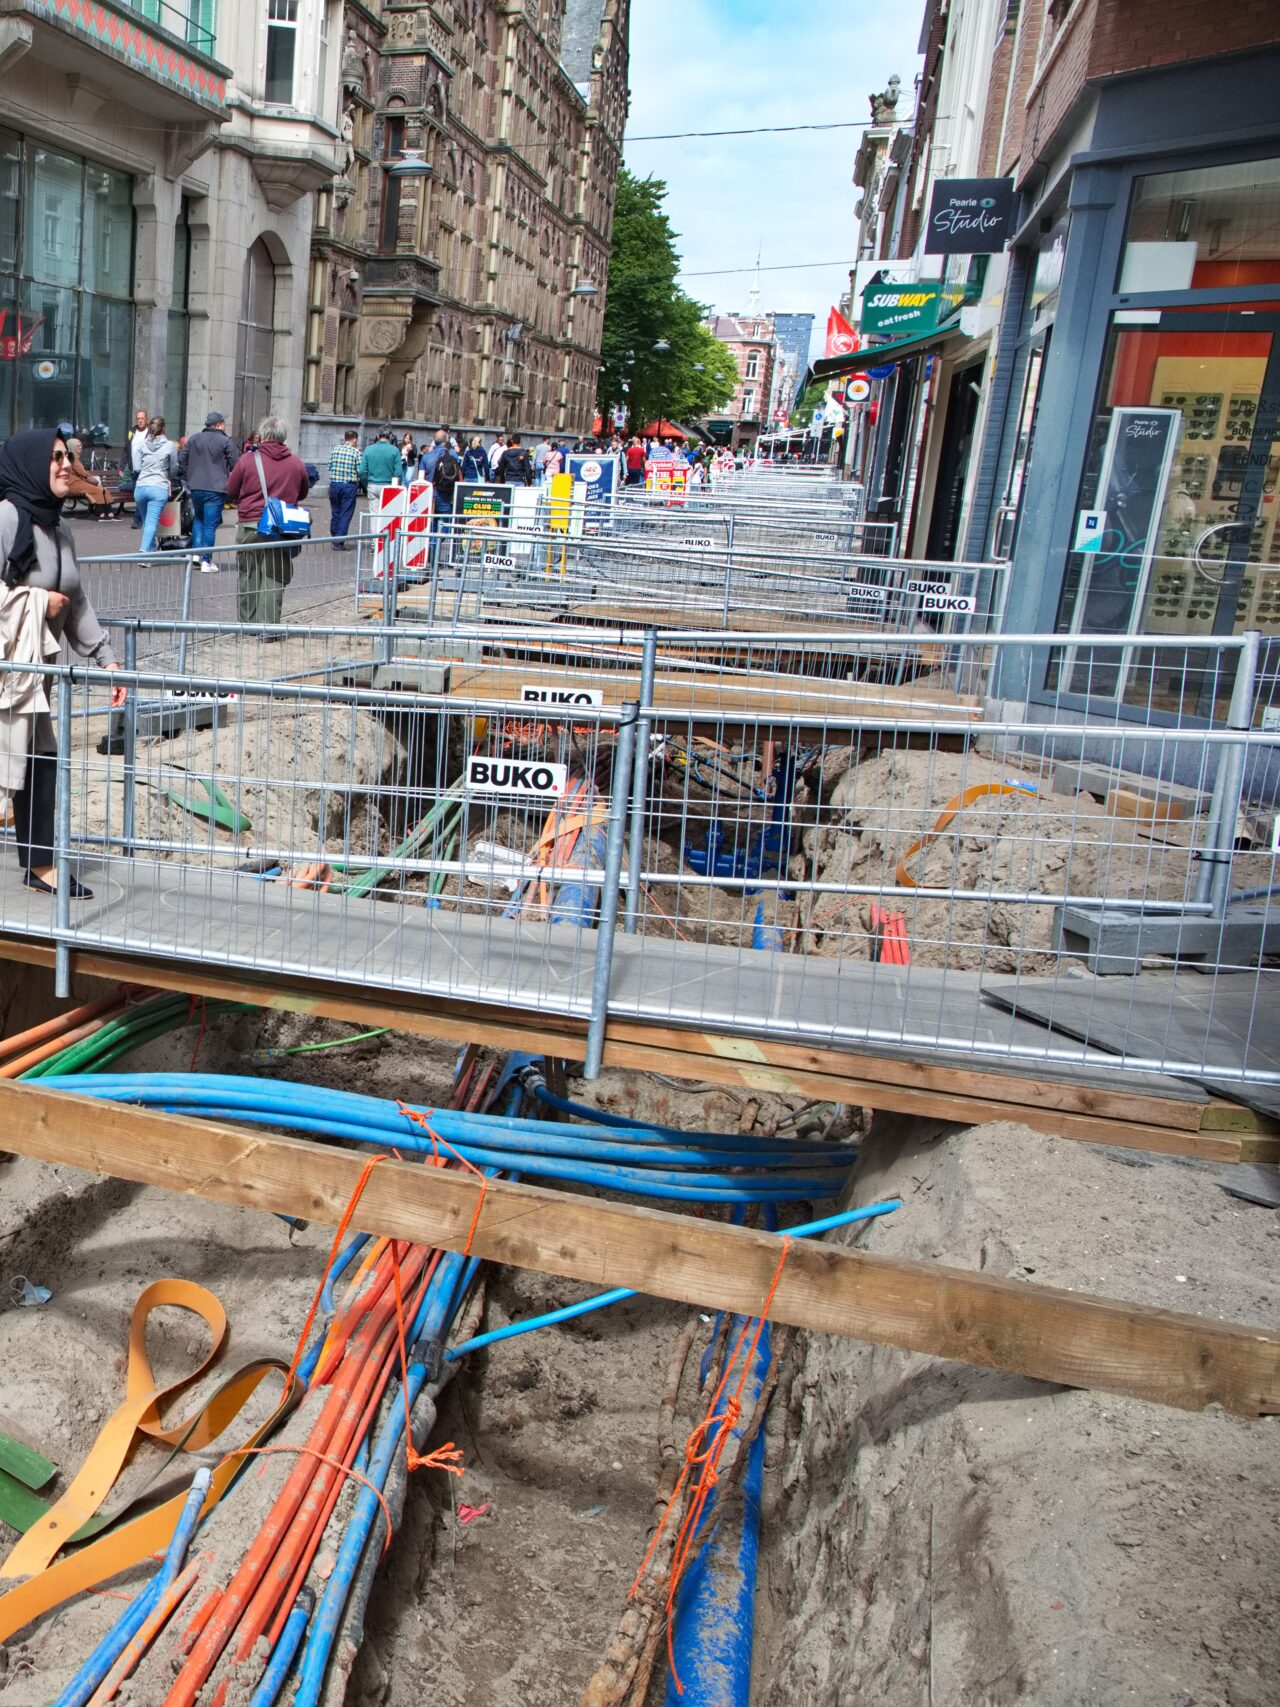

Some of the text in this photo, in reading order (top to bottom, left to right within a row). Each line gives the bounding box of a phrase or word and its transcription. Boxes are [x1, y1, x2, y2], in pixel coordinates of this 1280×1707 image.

[949, 198, 977, 207] Pearle
[933, 208, 1003, 234] Studio
[867, 292, 936, 307] SUBWAY
[877, 310, 921, 327] eat fresh
[1125, 424, 1162, 438] Studio
[925, 598, 971, 611] BUKO.
[470, 762, 558, 792] BUKO.
